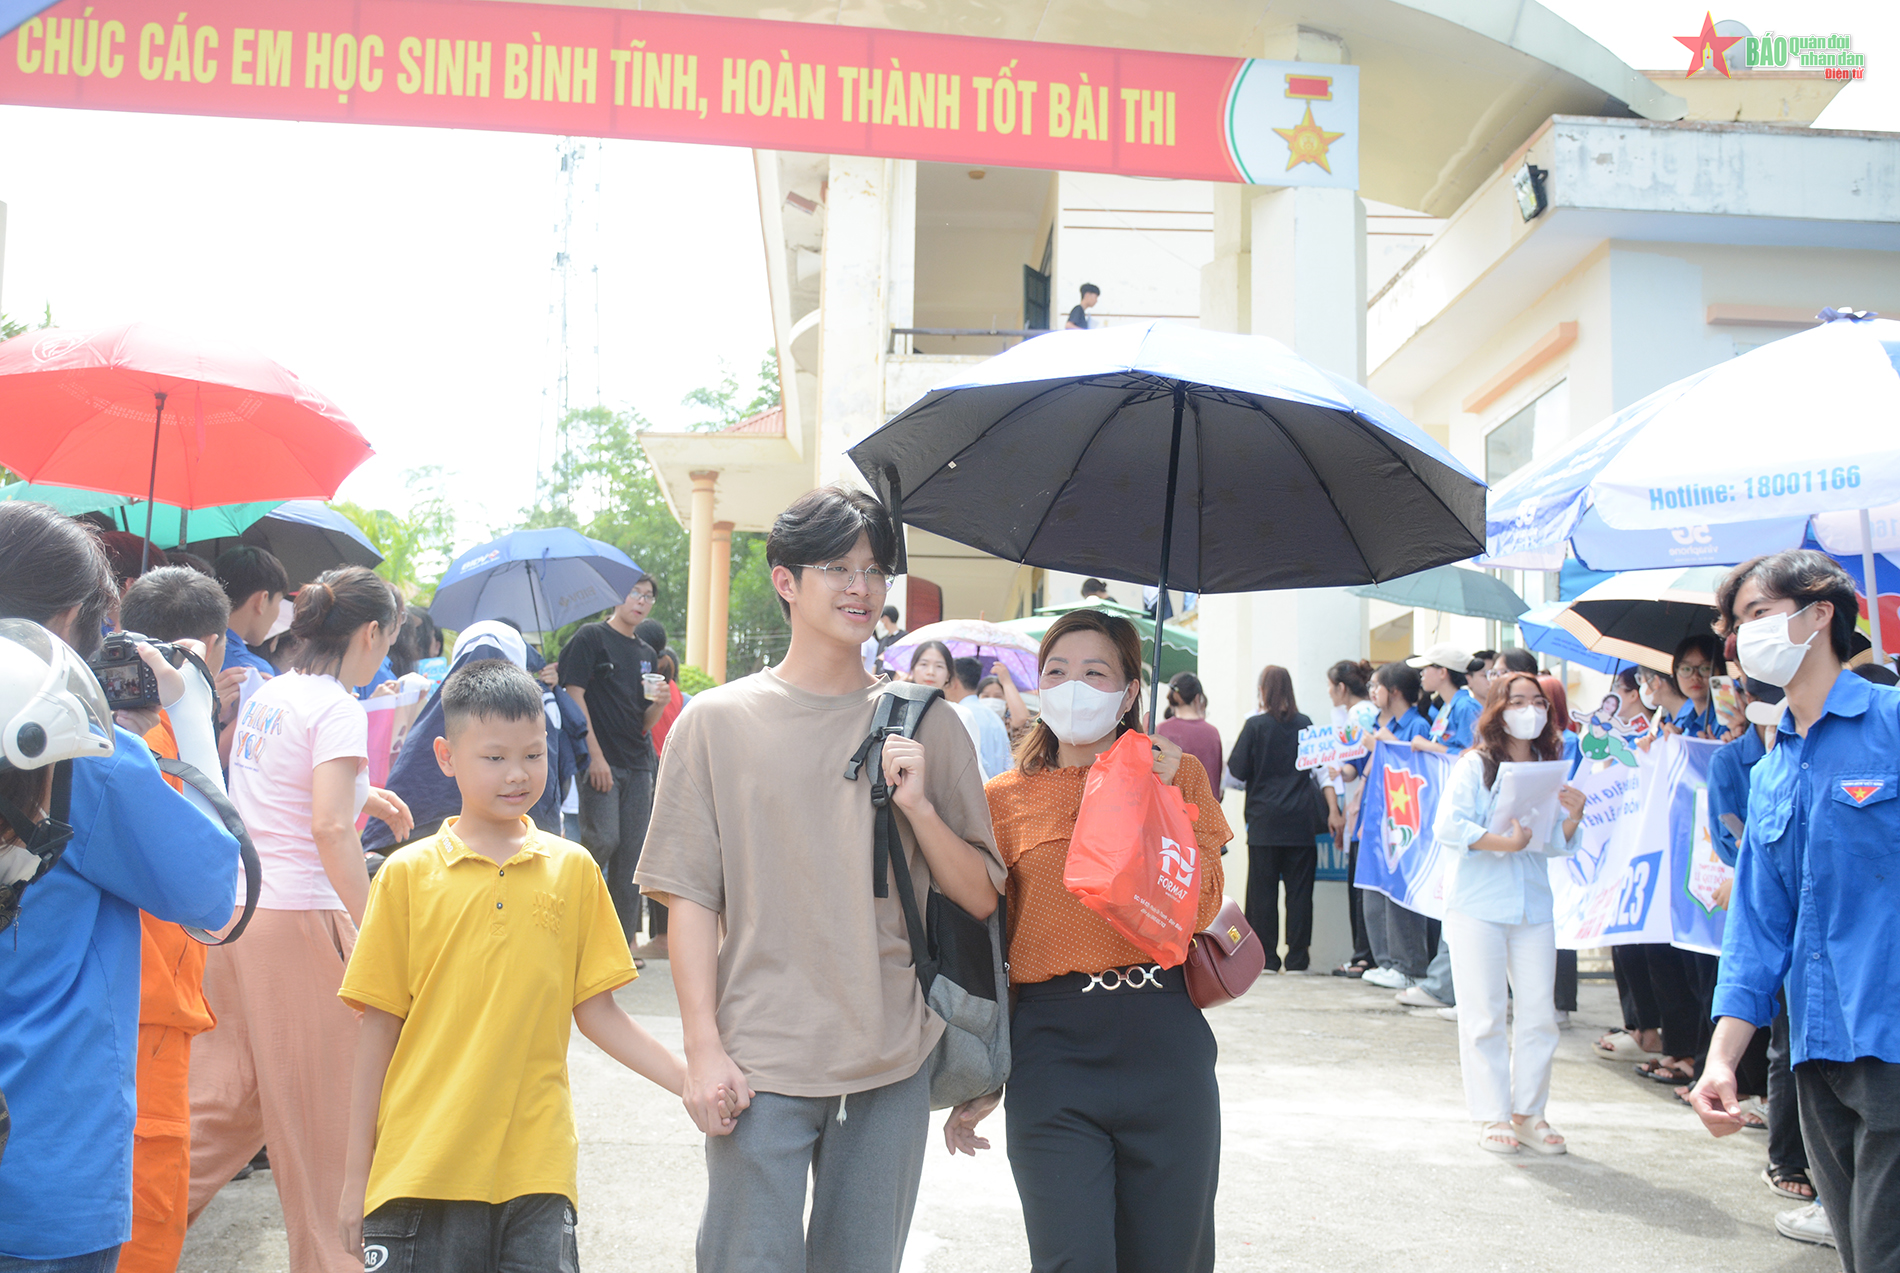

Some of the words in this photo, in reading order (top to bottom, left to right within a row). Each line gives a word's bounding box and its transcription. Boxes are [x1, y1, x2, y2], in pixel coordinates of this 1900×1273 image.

[17, 7, 125, 78] CHÚC
[138, 12, 219, 84] CÁC
[231, 28, 293, 87] EM
[305, 32, 383, 103] HỌC
[397, 36, 491, 98] SINH
[503, 32, 597, 104] BÌNH
[610, 40, 707, 119] TĨNH,
[722, 49, 825, 120] HOÀN
[838, 58, 959, 130] THÀNH
[972, 59, 1037, 135] TỐT
[1049, 73, 1108, 141] BÀI
[1121, 88, 1175, 147] THI
[1649, 481, 1736, 511] Hotline:
[1744, 465, 1862, 499] 18001166
[240, 701, 289, 735] THANK
[237, 730, 267, 764] YOU
[1157, 874, 1188, 900] FORMAT
